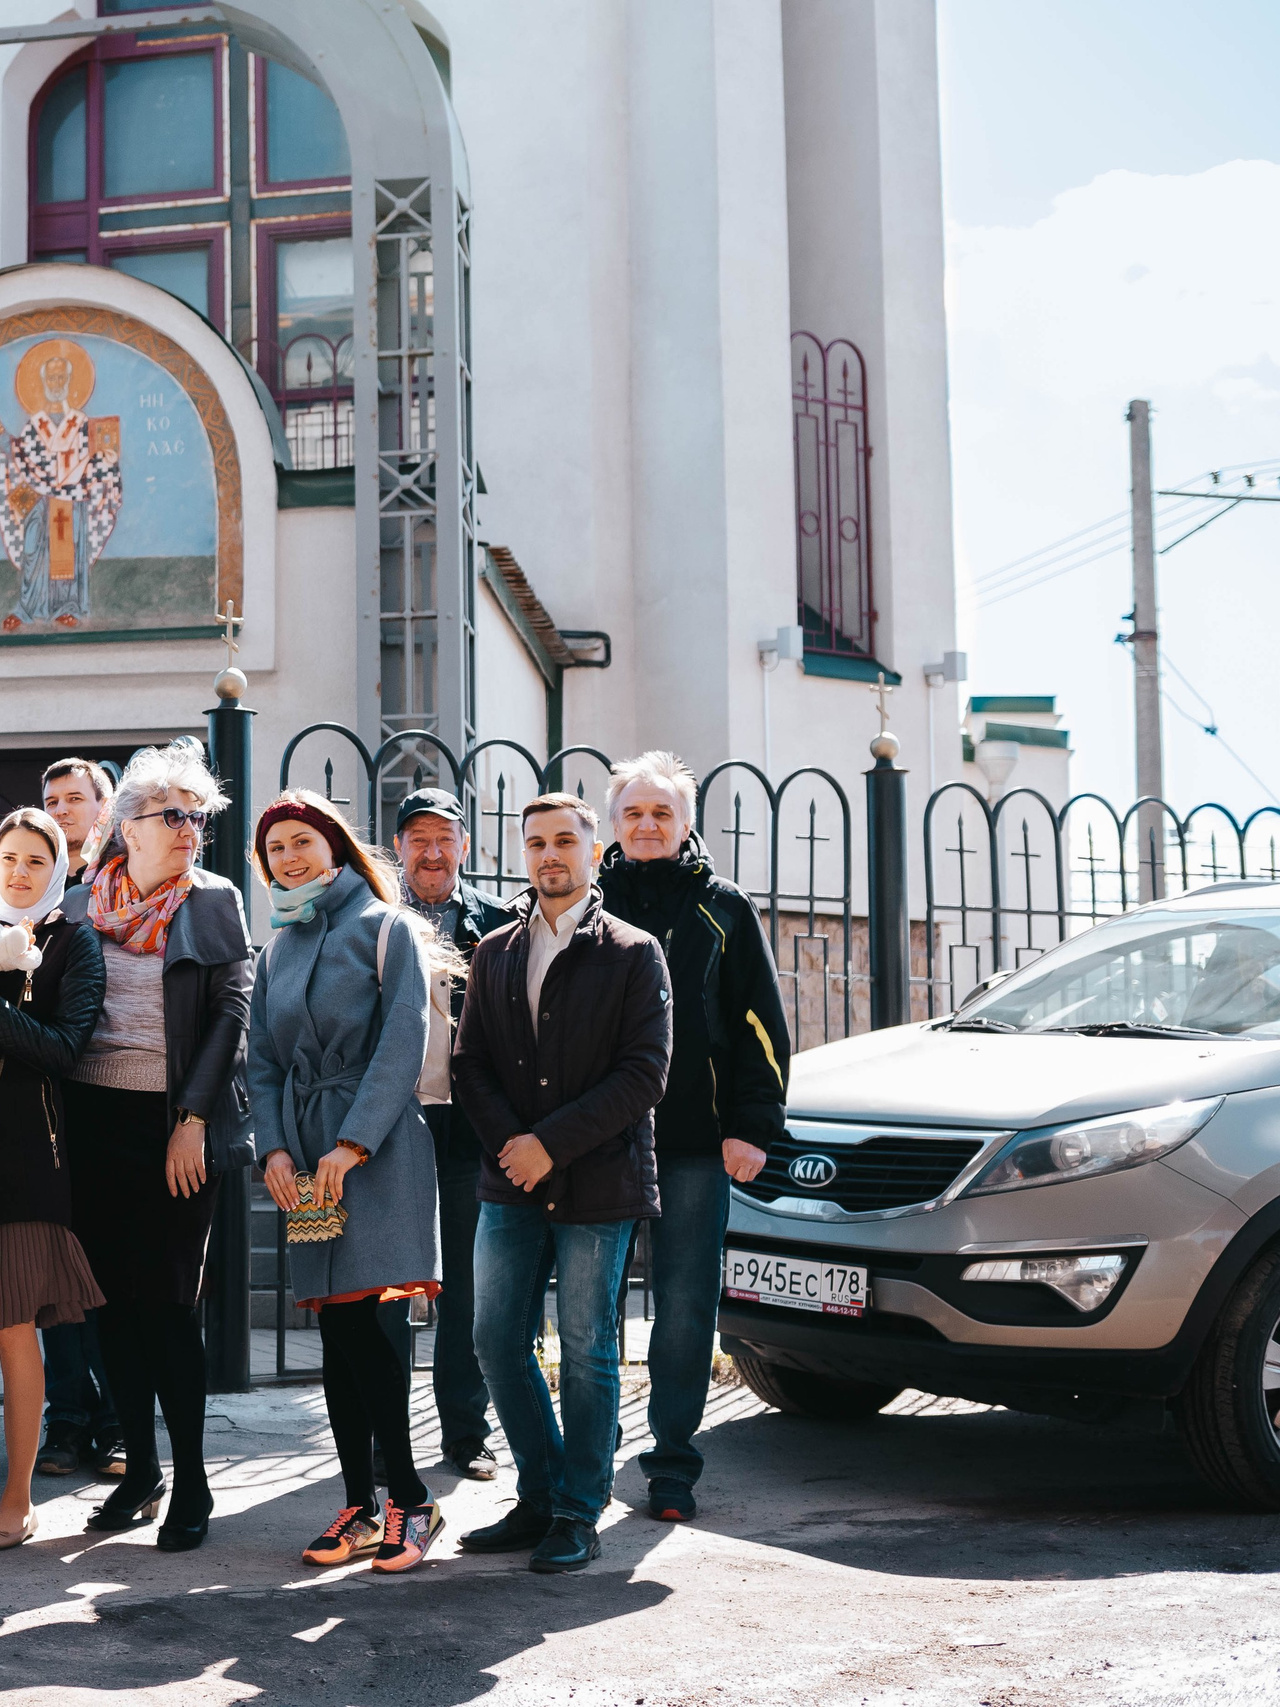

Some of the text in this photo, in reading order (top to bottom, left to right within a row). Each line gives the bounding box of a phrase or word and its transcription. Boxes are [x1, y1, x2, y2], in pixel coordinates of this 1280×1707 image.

[146, 415, 171, 432] КО
[794, 1159, 826, 1181] KIA
[733, 1258, 860, 1298] Р945ЕС 178
[831, 1293, 850, 1304] RUS
[825, 1304, 859, 1317] 448-12-12
